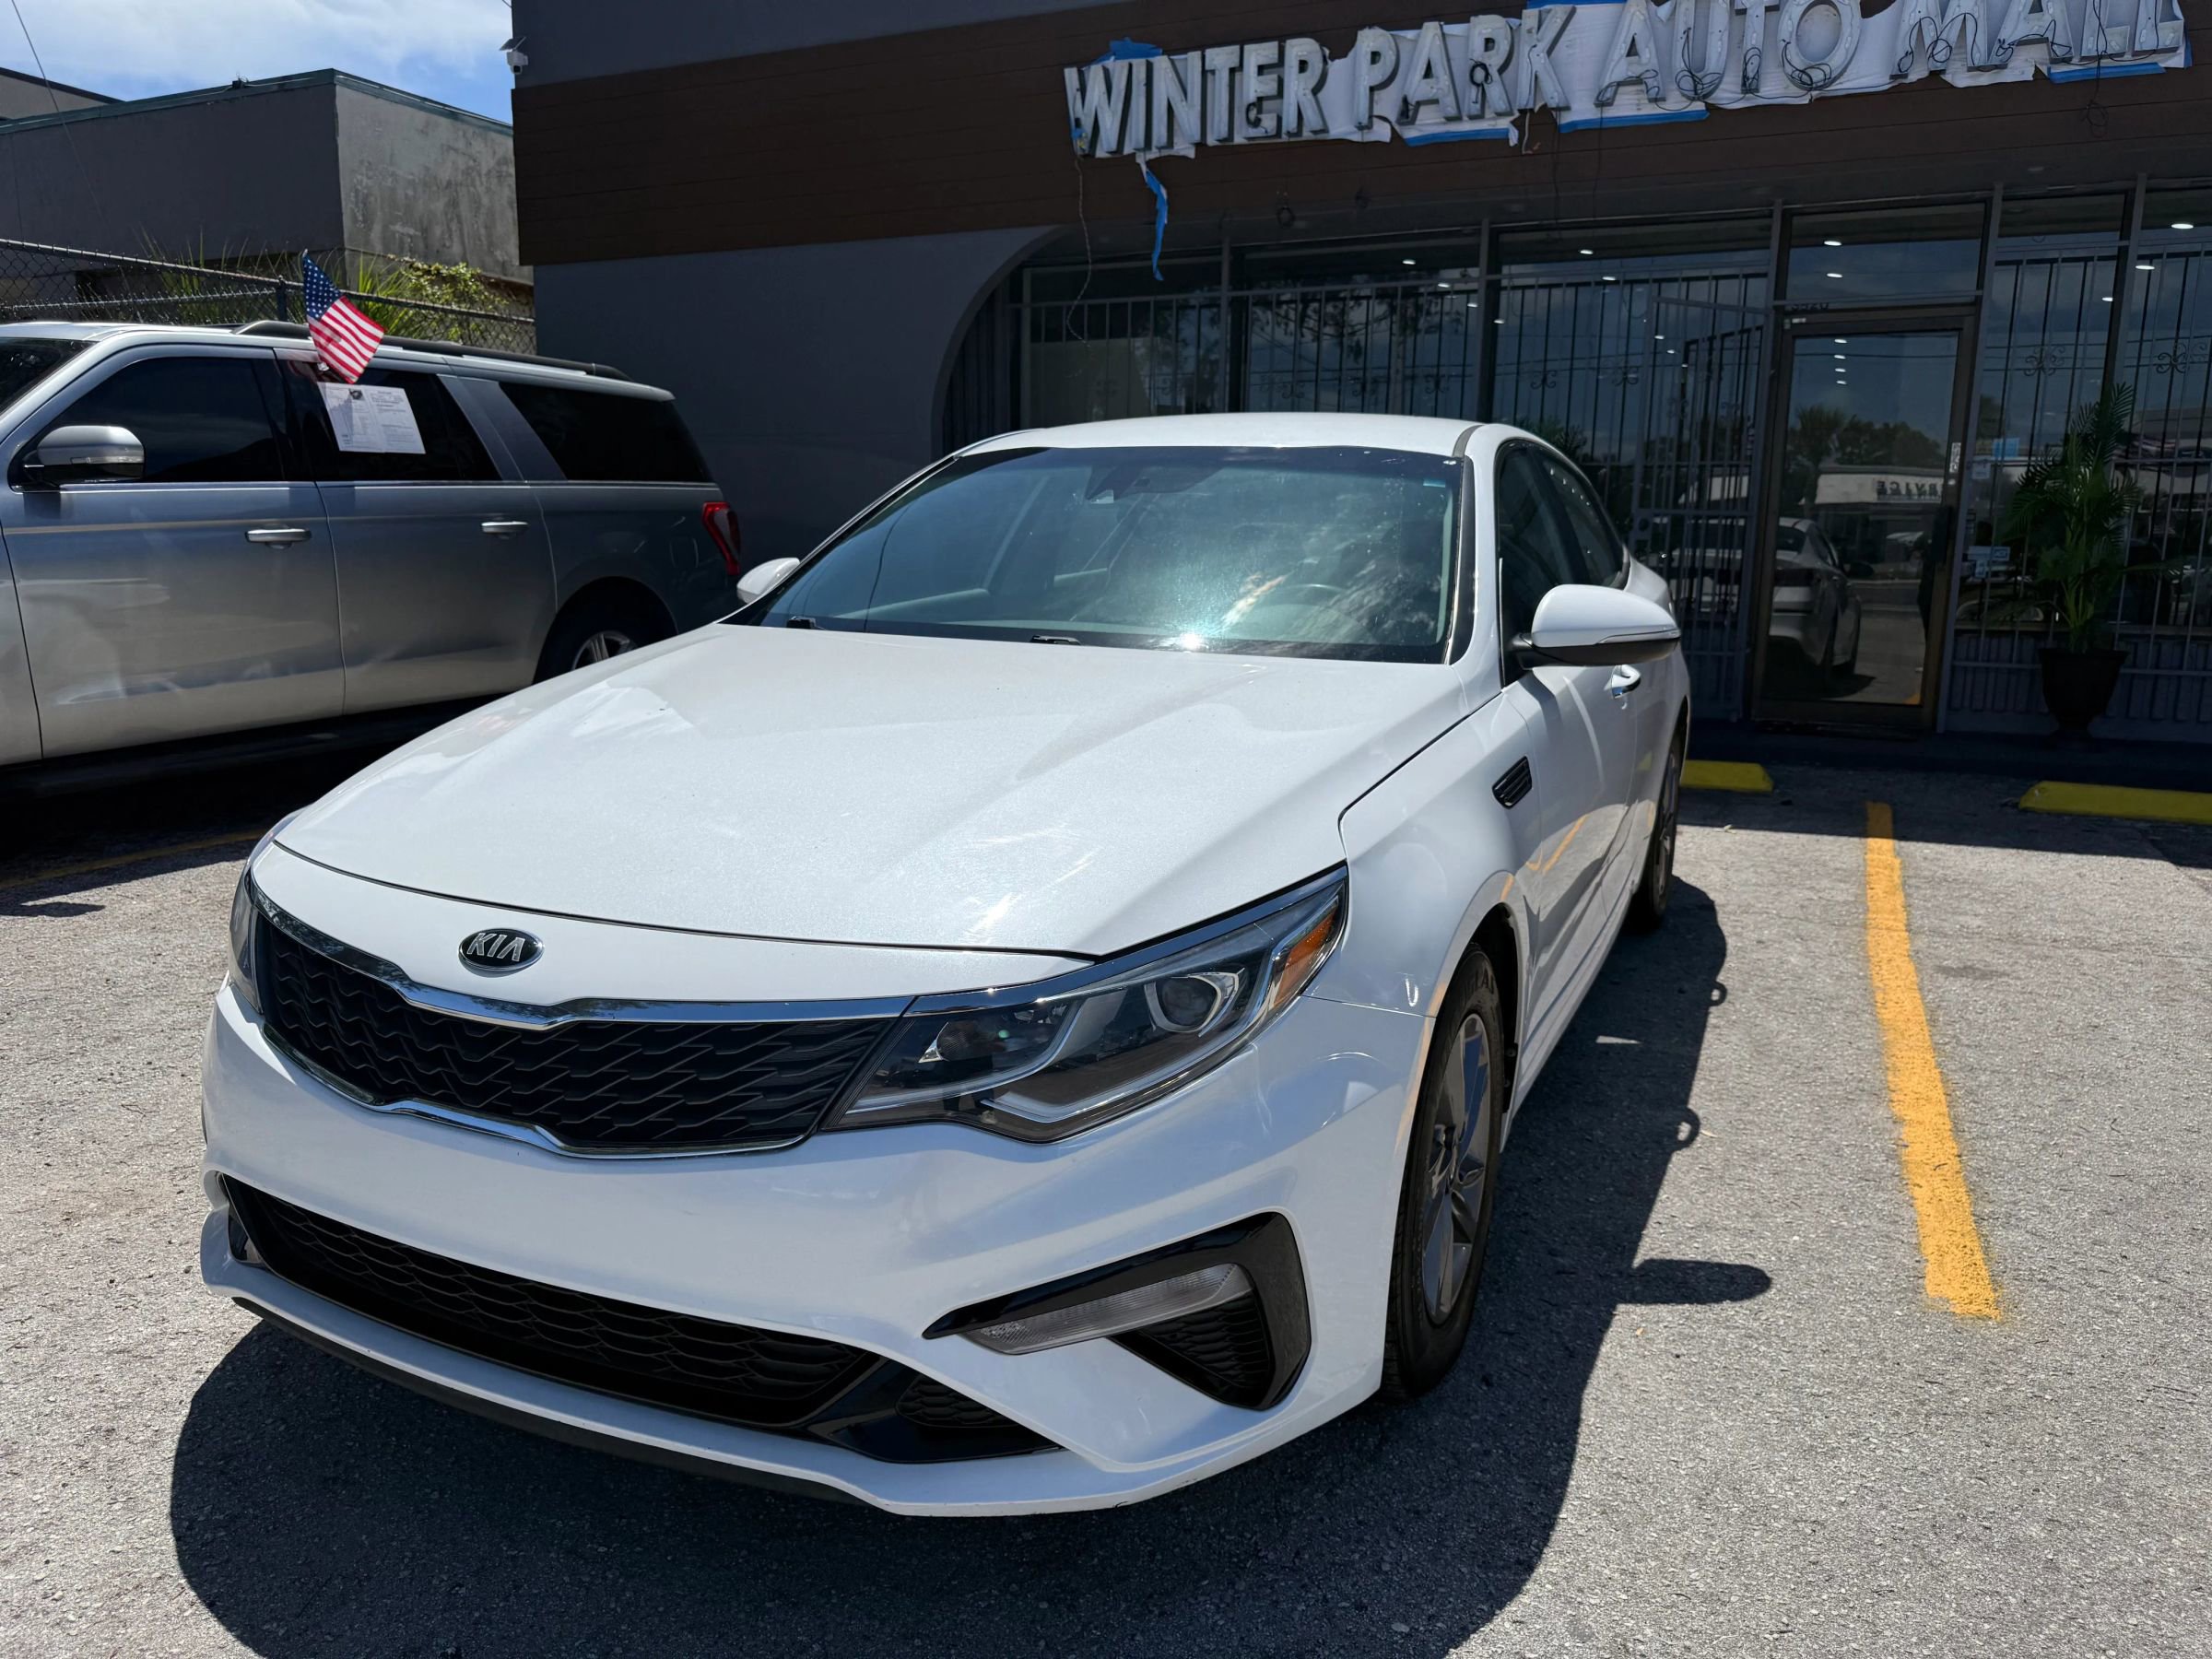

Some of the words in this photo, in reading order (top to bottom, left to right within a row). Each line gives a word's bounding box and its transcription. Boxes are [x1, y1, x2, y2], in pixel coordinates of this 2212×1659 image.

[1064, 38, 1329, 156] WINTER
[1352, 6, 1577, 130] PARK
[1594, 0, 1862, 107] AUTO
[466, 932, 525, 962] KIA
